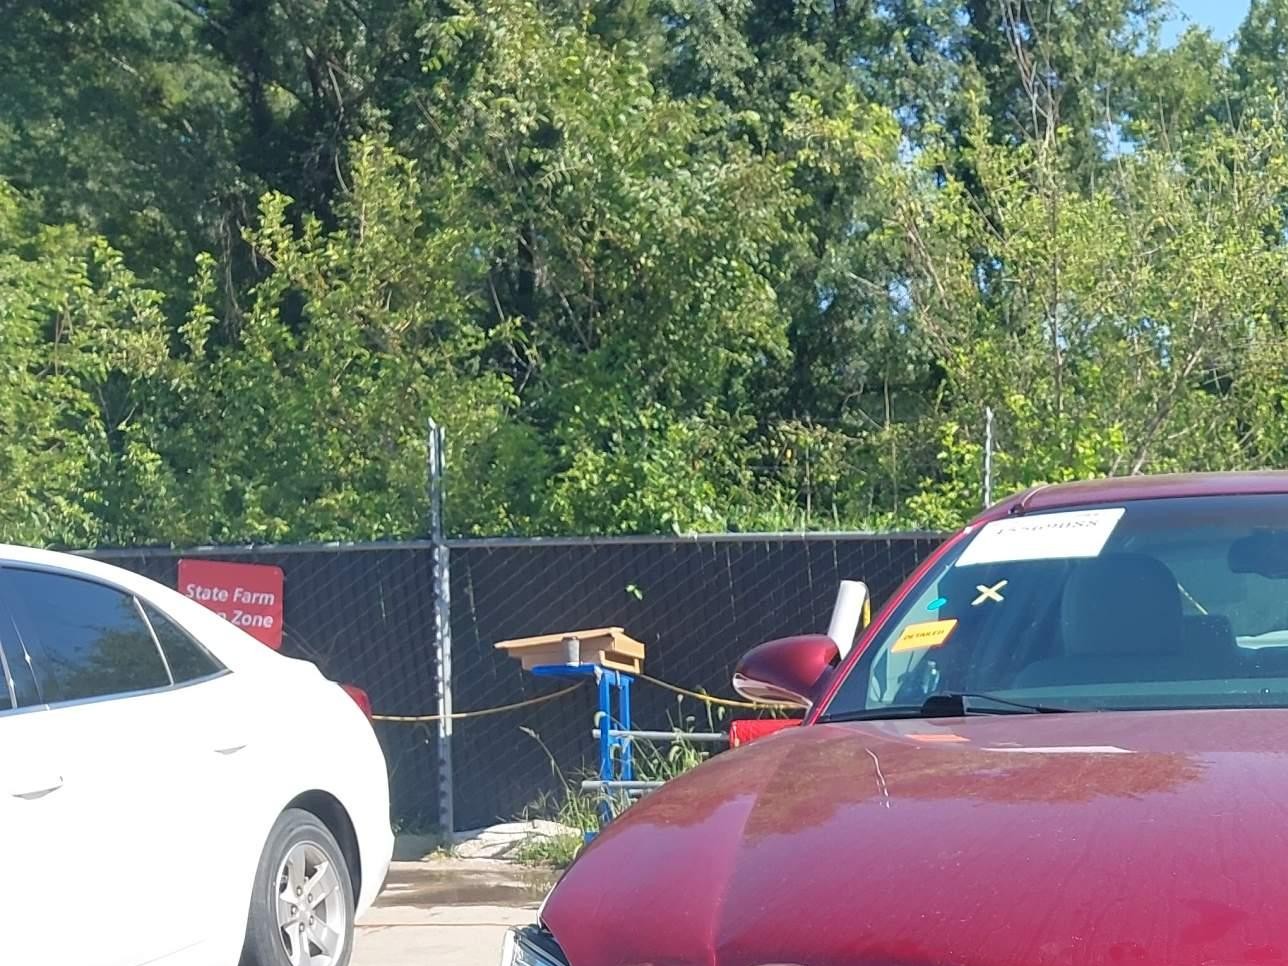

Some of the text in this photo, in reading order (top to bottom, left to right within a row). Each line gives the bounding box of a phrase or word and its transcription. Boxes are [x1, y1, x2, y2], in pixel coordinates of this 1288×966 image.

[186, 583, 275, 606] State Farm
[231, 609, 274, 629] Zone
